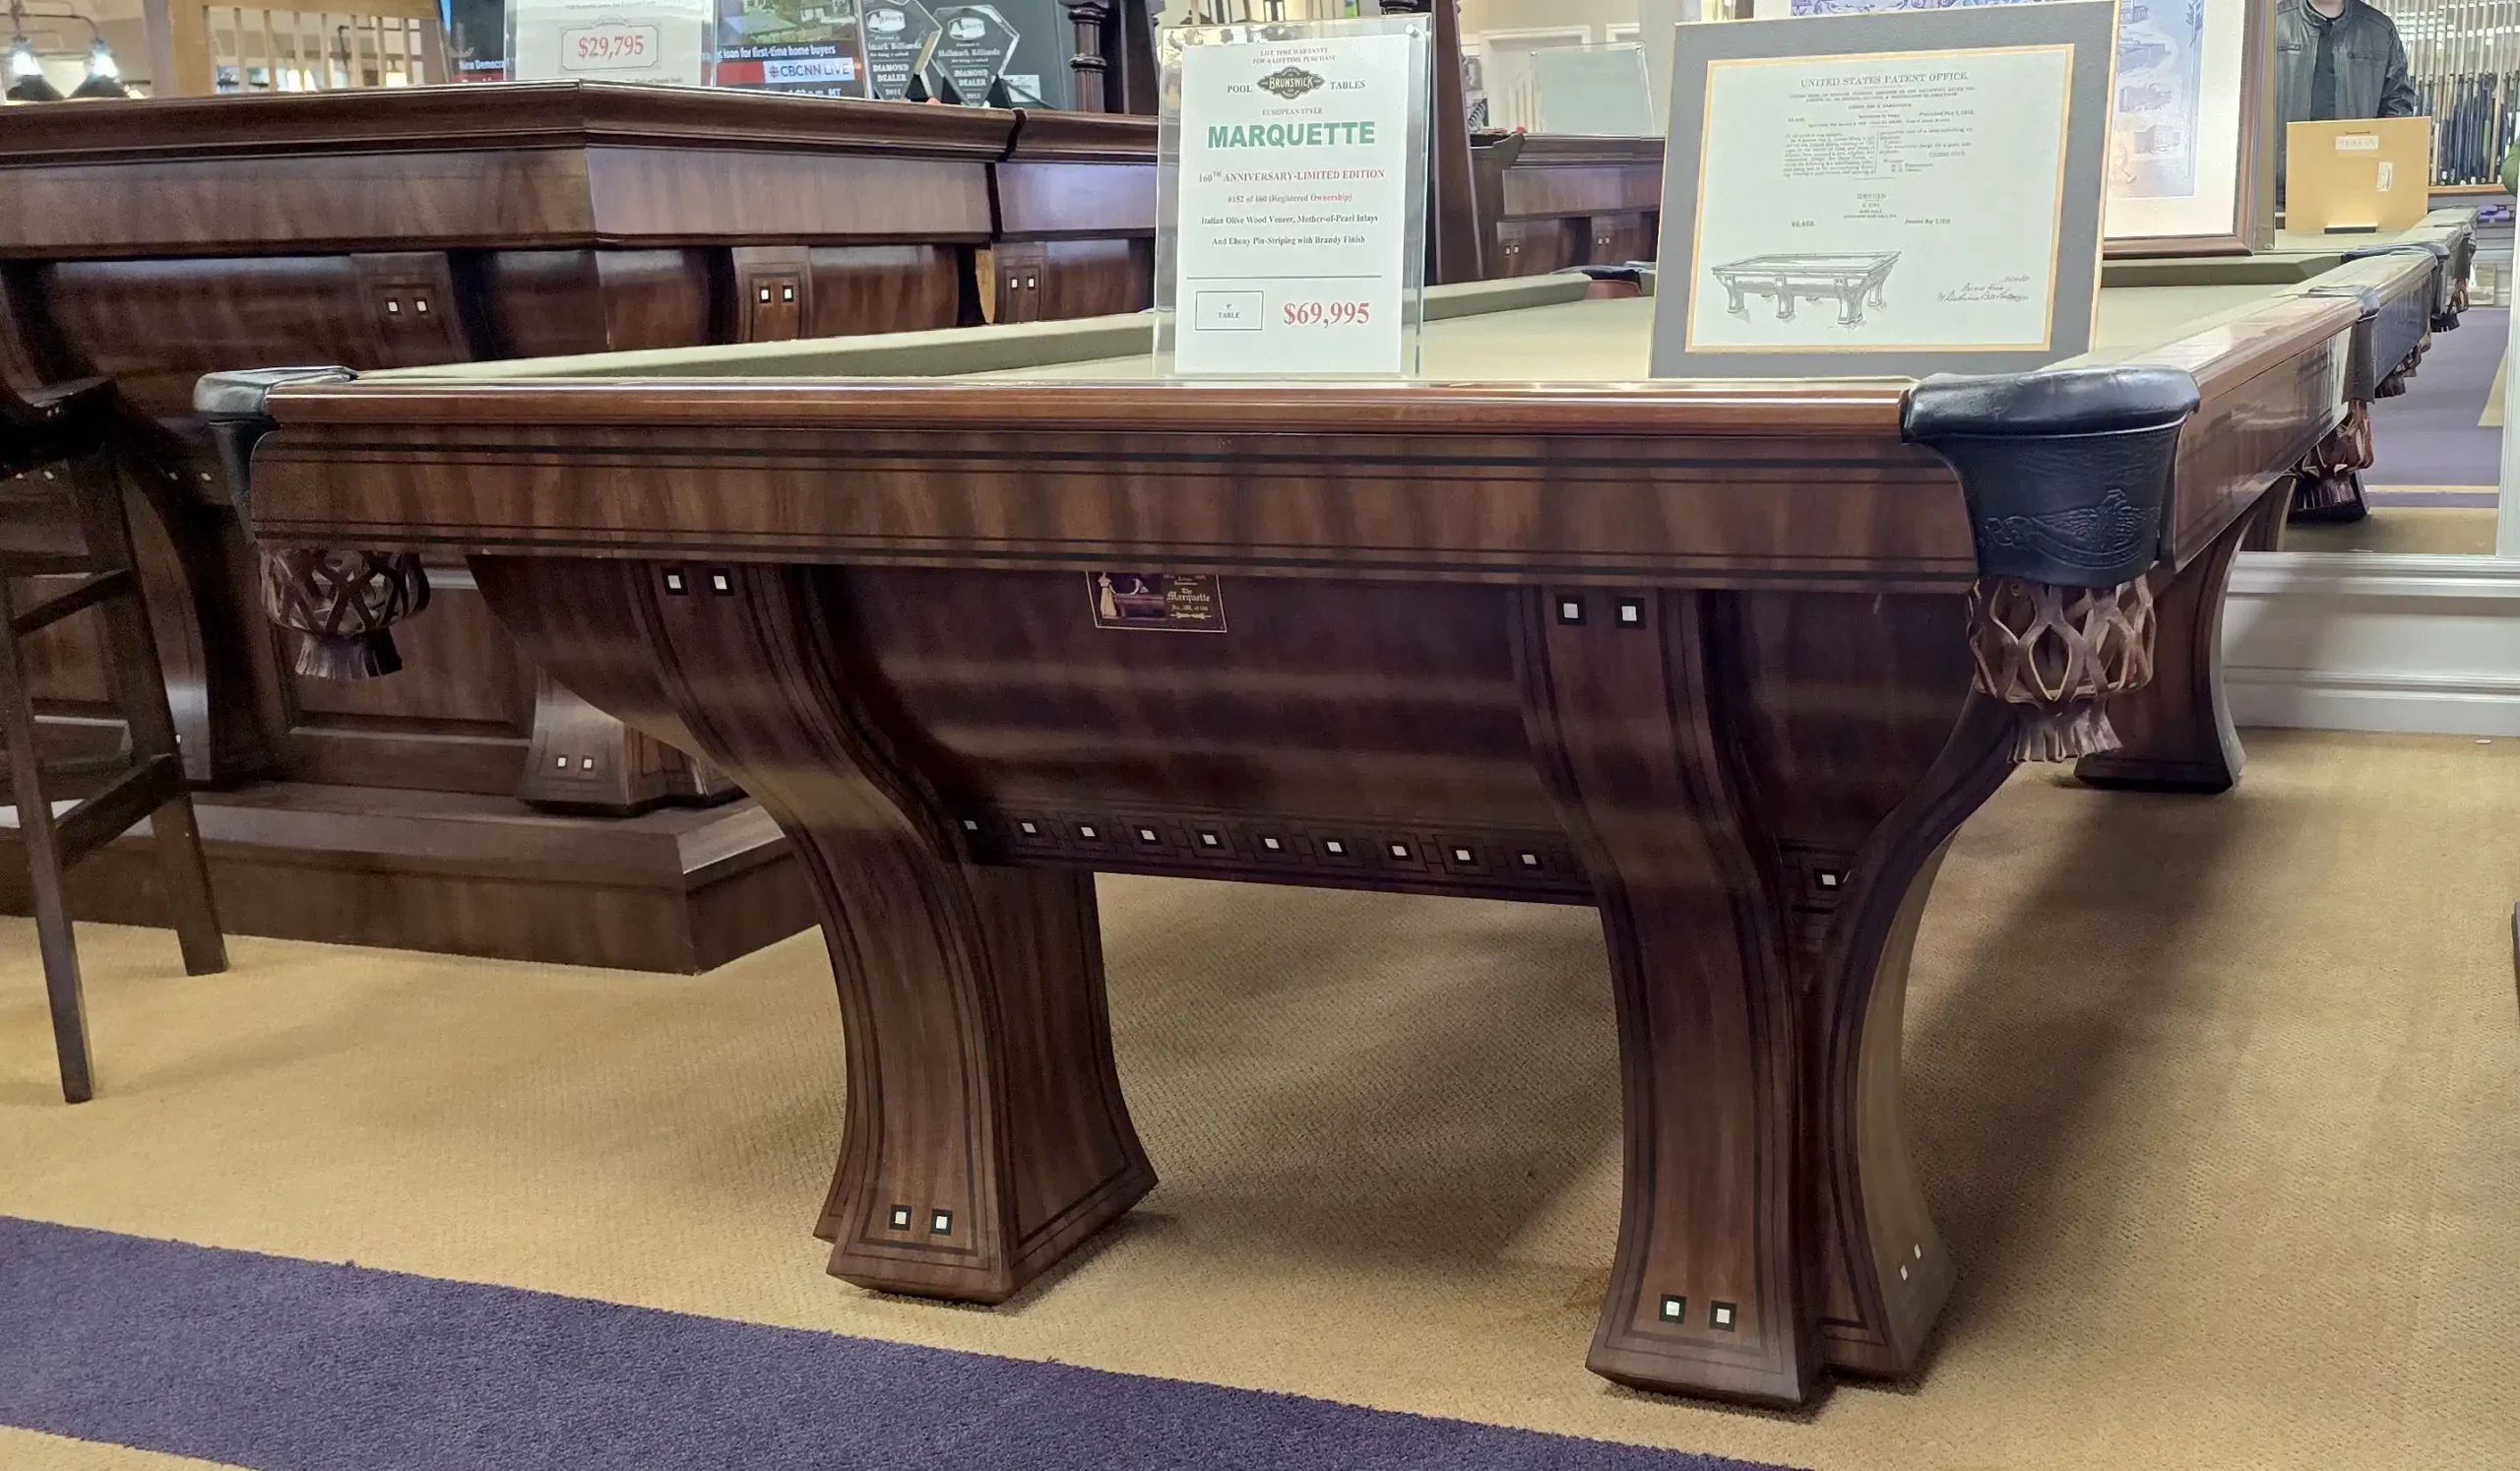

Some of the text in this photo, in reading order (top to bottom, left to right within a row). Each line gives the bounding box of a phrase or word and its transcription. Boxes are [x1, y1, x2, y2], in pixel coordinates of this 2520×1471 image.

[578, 35, 644, 61] $29,795
[723, 48, 739, 59] loan
[739, 46, 751, 58] for
[752, 45, 788, 58] first-time
[788, 45, 809, 56] home
[810, 44, 836, 57] buyers
[872, 63, 910, 72] DIAMOND
[954, 69, 988, 78] DIAMOND
[877, 73, 907, 83] DEALER
[1228, 75, 1365, 94] POOL BRUNSWICK TABLES
[1800, 78, 1840, 88] UNITED
[1843, 76, 1881, 86] STATES
[1885, 74, 1926, 84] PATENT
[1208, 121, 1375, 149] MARQUETTE
[1224, 170, 1340, 182] ANNIVERSARY-LIMITED
[1342, 169, 1385, 180] EDITION
[1269, 194, 1308, 204] (Registered
[1310, 193, 1353, 203] Ownership)
[1246, 216, 1267, 224] Wood
[1269, 216, 1296, 224] Veneer,
[1297, 215, 1355, 224] Mother-of-Pearl
[1356, 214, 1378, 224] Inlays
[1228, 237, 1251, 246] Ebony
[1253, 237, 1296, 246] Pin-Striping
[1315, 236, 1342, 245] Brandy
[1344, 235, 1365, 244] Finish
[1284, 302, 1369, 328] $69,995
[1166, 591, 1210, 604] Marquette
